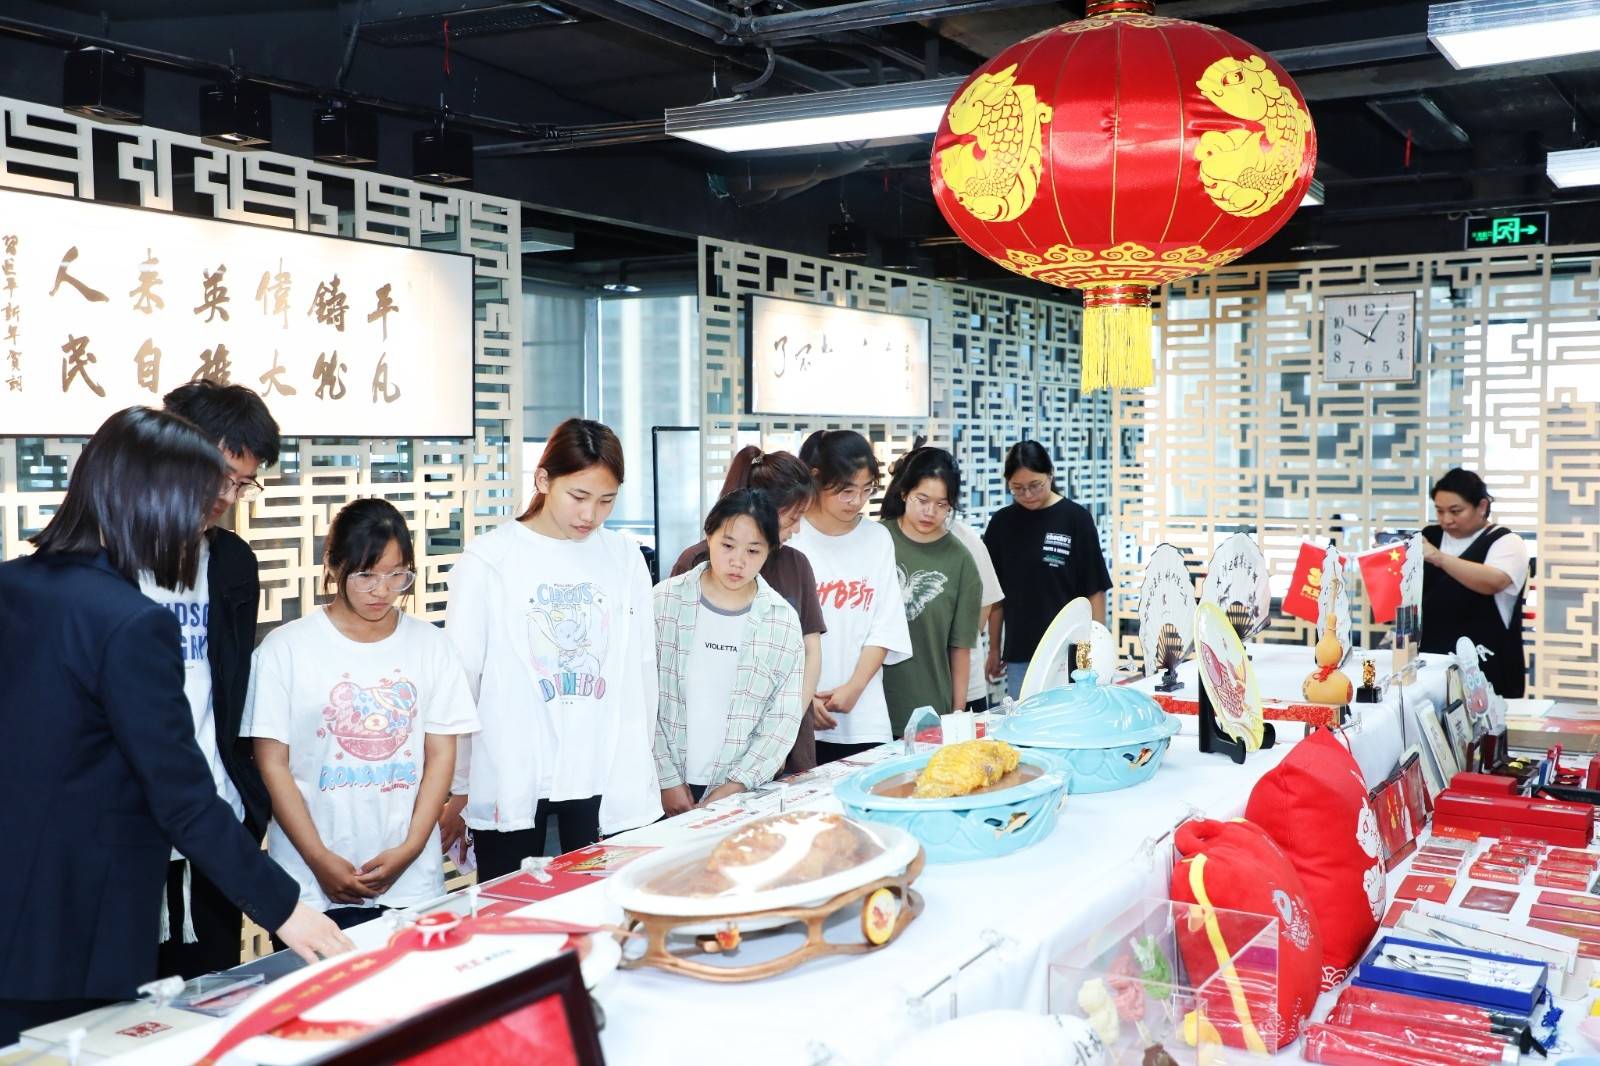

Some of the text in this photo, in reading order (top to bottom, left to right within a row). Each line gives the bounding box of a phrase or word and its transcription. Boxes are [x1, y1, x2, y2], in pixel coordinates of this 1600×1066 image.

[1348, 304, 1357, 317] 11
[1364, 303, 1376, 316] 12
[49, 245, 110, 398] 人民
[1334, 317, 1344, 329] 10
[1398, 313, 1406, 326] 2
[1334, 333, 1341, 346] 9
[1397, 331, 1405, 343] 3
[1334, 351, 1341, 363] 8
[1397, 348, 1403, 360] 4
[1348, 361, 1355, 373] 7
[1365, 361, 1372, 373] 6
[1383, 360, 1390, 373] 5
[704, 641, 738, 653] VIOLETTA
[538, 672, 606, 703] DUMBO
